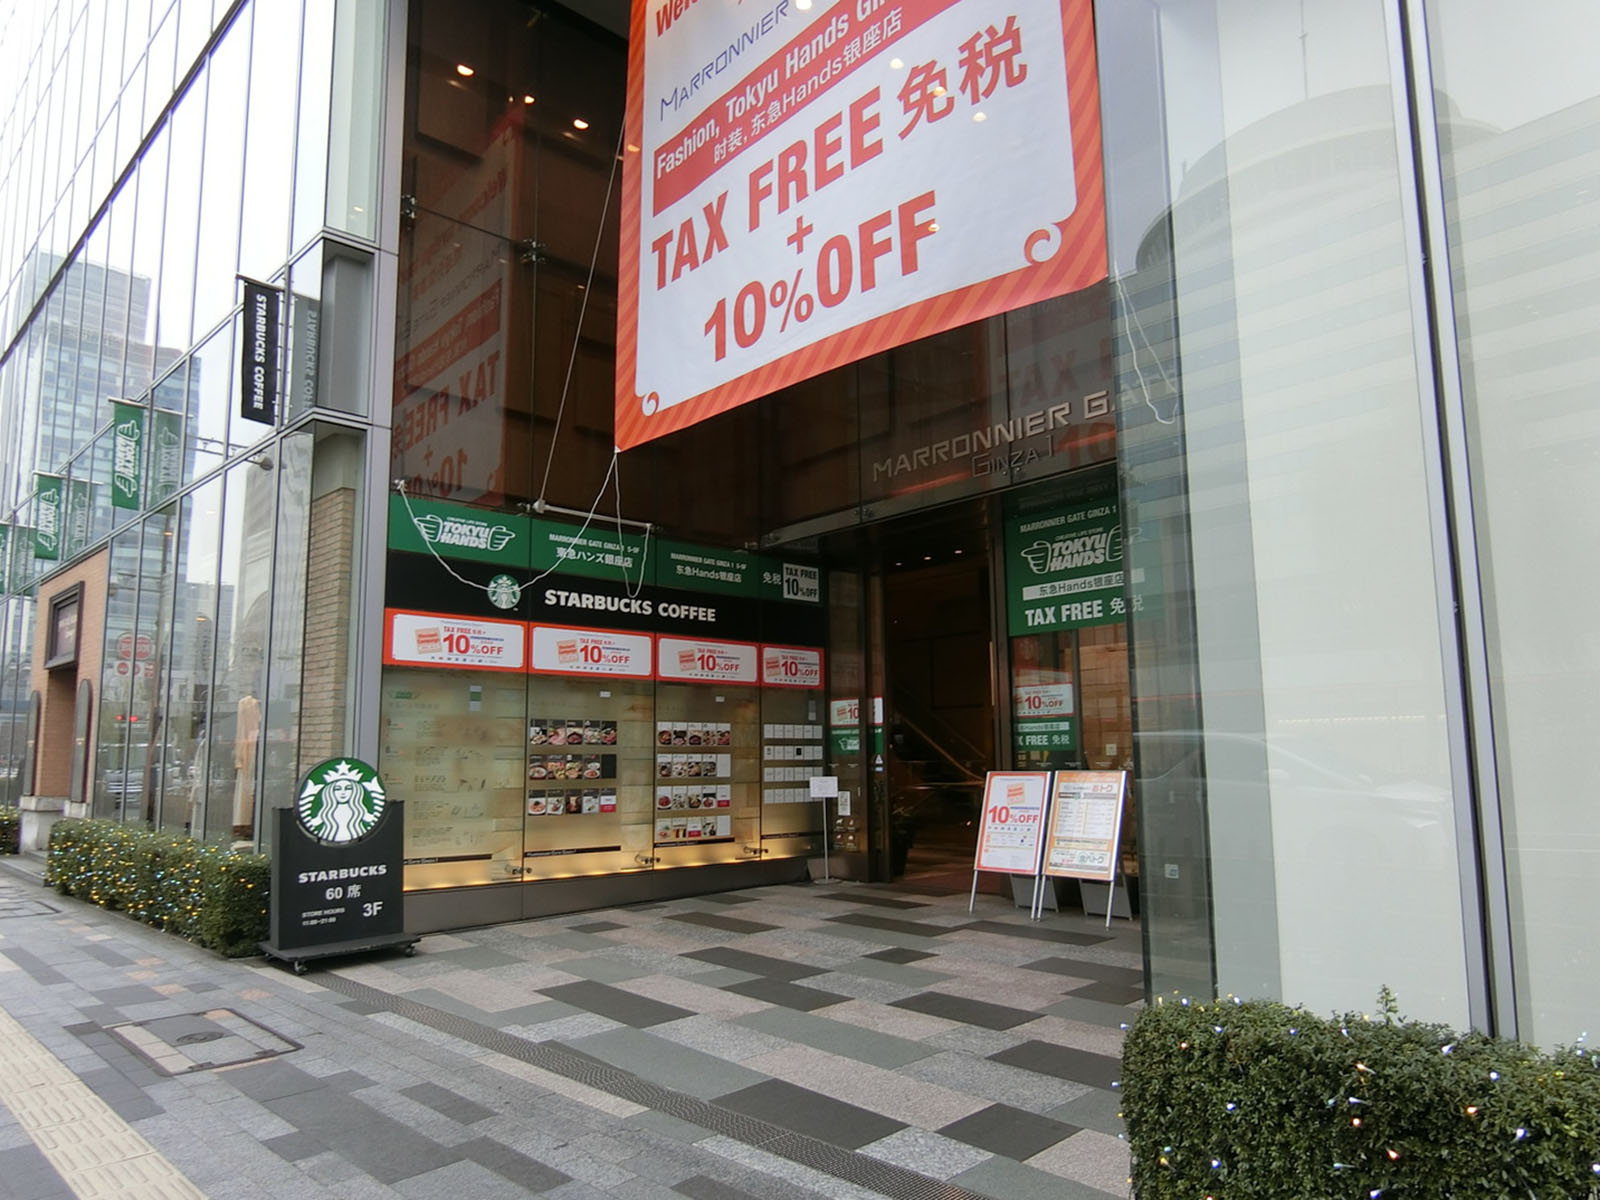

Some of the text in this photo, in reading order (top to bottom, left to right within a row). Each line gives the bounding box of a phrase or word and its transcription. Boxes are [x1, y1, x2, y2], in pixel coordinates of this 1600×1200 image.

[660, 0, 789, 122] MARRONNIER
[657, 118, 720, 179] Fashion,
[725, 68, 779, 123] Tokyu
[785, 12, 849, 80] Hands
[651, 191, 729, 291] TAX
[748, 85, 883, 232] FREE
[897, 15, 1028, 139] 免税
[704, 190, 937, 362] 10%OFF
[253, 293, 267, 410] STARBUCKS COFFEE
[873, 401, 1072, 482] MARRONNIER
[1067, 511, 1087, 524] GATE
[1087, 507, 1111, 520] GINZA
[440, 532, 487, 549] HANDS
[443, 521, 490, 538] TOKYU
[1052, 533, 1107, 557] TOKYU
[1050, 549, 1105, 571] HANDS
[785, 567, 817, 580] TAX FREE
[545, 590, 716, 622] STARBUCKS COFFEE
[1025, 606, 1056, 626] TAX
[1061, 600, 1103, 621] FREE
[1026, 735, 1048, 745] FREE
[298, 864, 387, 883] STARBUCKS
[325, 887, 343, 900] 60
[363, 901, 383, 917] 3F
